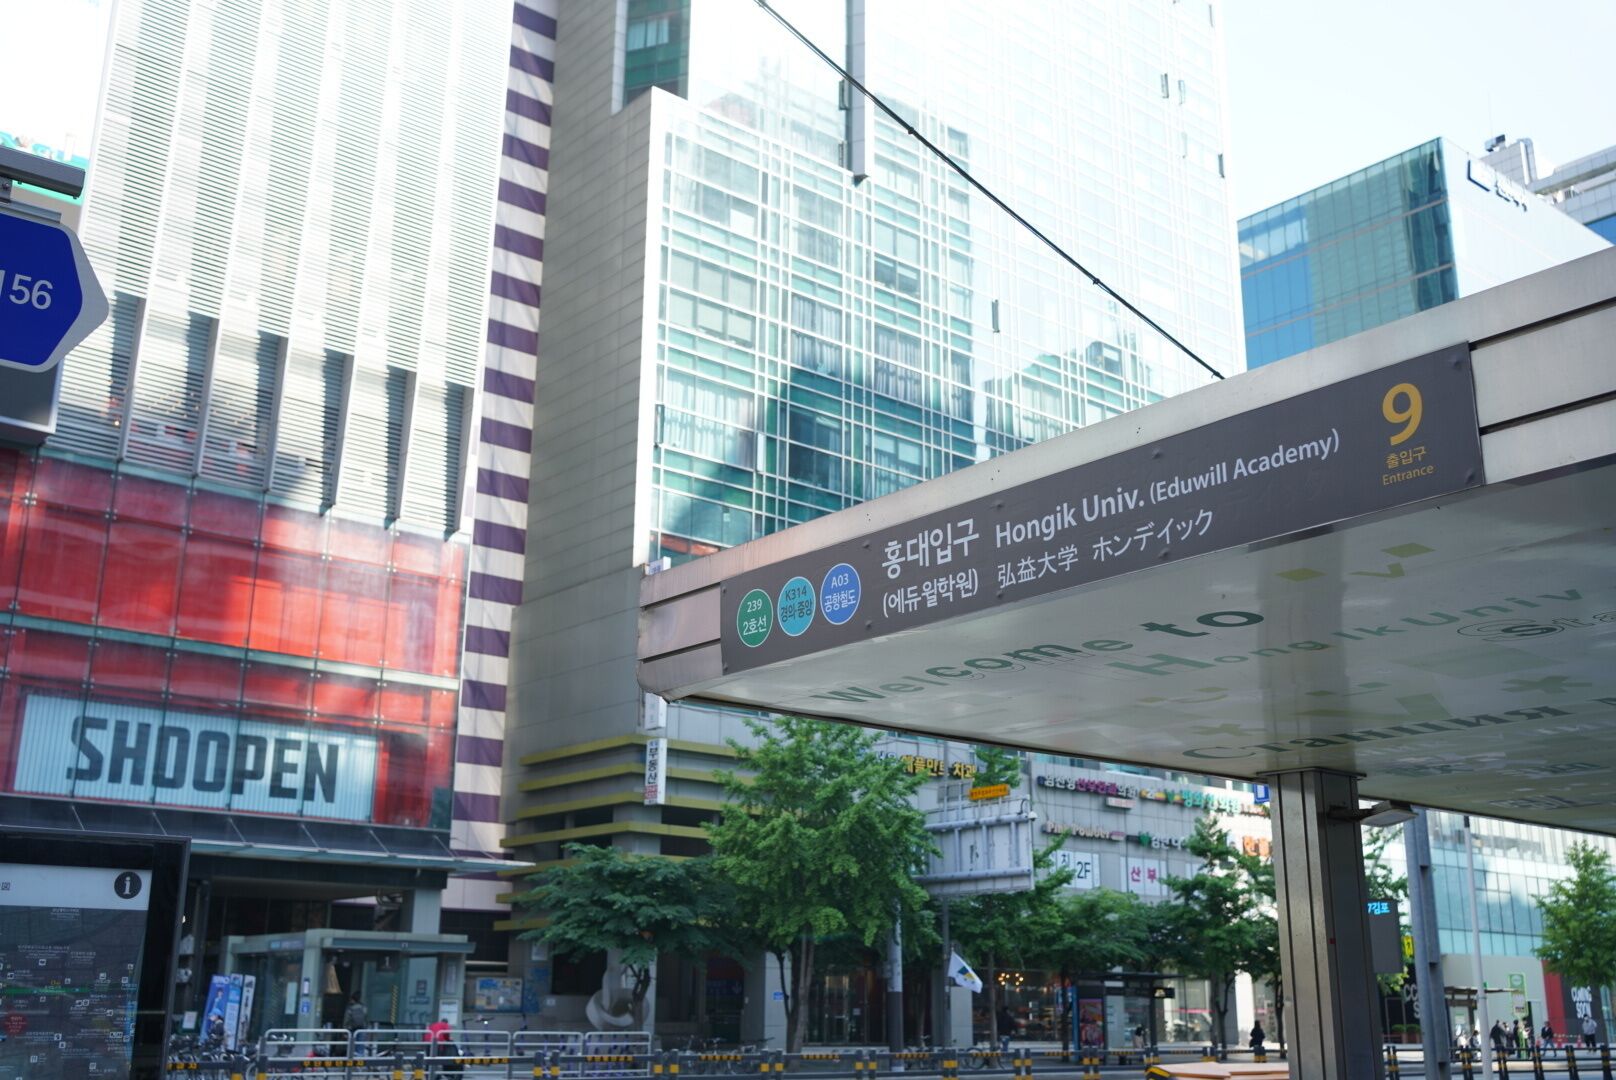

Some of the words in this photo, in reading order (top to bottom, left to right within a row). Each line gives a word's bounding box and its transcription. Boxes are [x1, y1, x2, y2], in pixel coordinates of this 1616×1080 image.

[1382, 383, 1423, 446] 9
[1386, 446, 1427, 469] 출입구
[1382, 465, 1434, 486] Entrance
[995, 502, 1078, 549] Hongik
[1082, 486, 1145, 523] Univ.
[1150, 462, 1228, 505] (Eduwill
[1233, 428, 1340, 480] Academy)
[881, 517, 981, 580] 홍대입구
[997, 543, 1079, 590] 弘益大学
[831, 572, 850, 588] A03
[785, 584, 808, 601] K314
[823, 589, 857, 613] 공항철도
[882, 568, 979, 618] (에듀윌학원)
[746, 598, 763, 613] 239
[742, 616, 768, 636] 2호선
[811, 638, 1134, 704] Welcome
[1138, 610, 1266, 639] to
[65, 715, 340, 804] SHOOPEN
[1076, 861, 1091, 879] 2F
